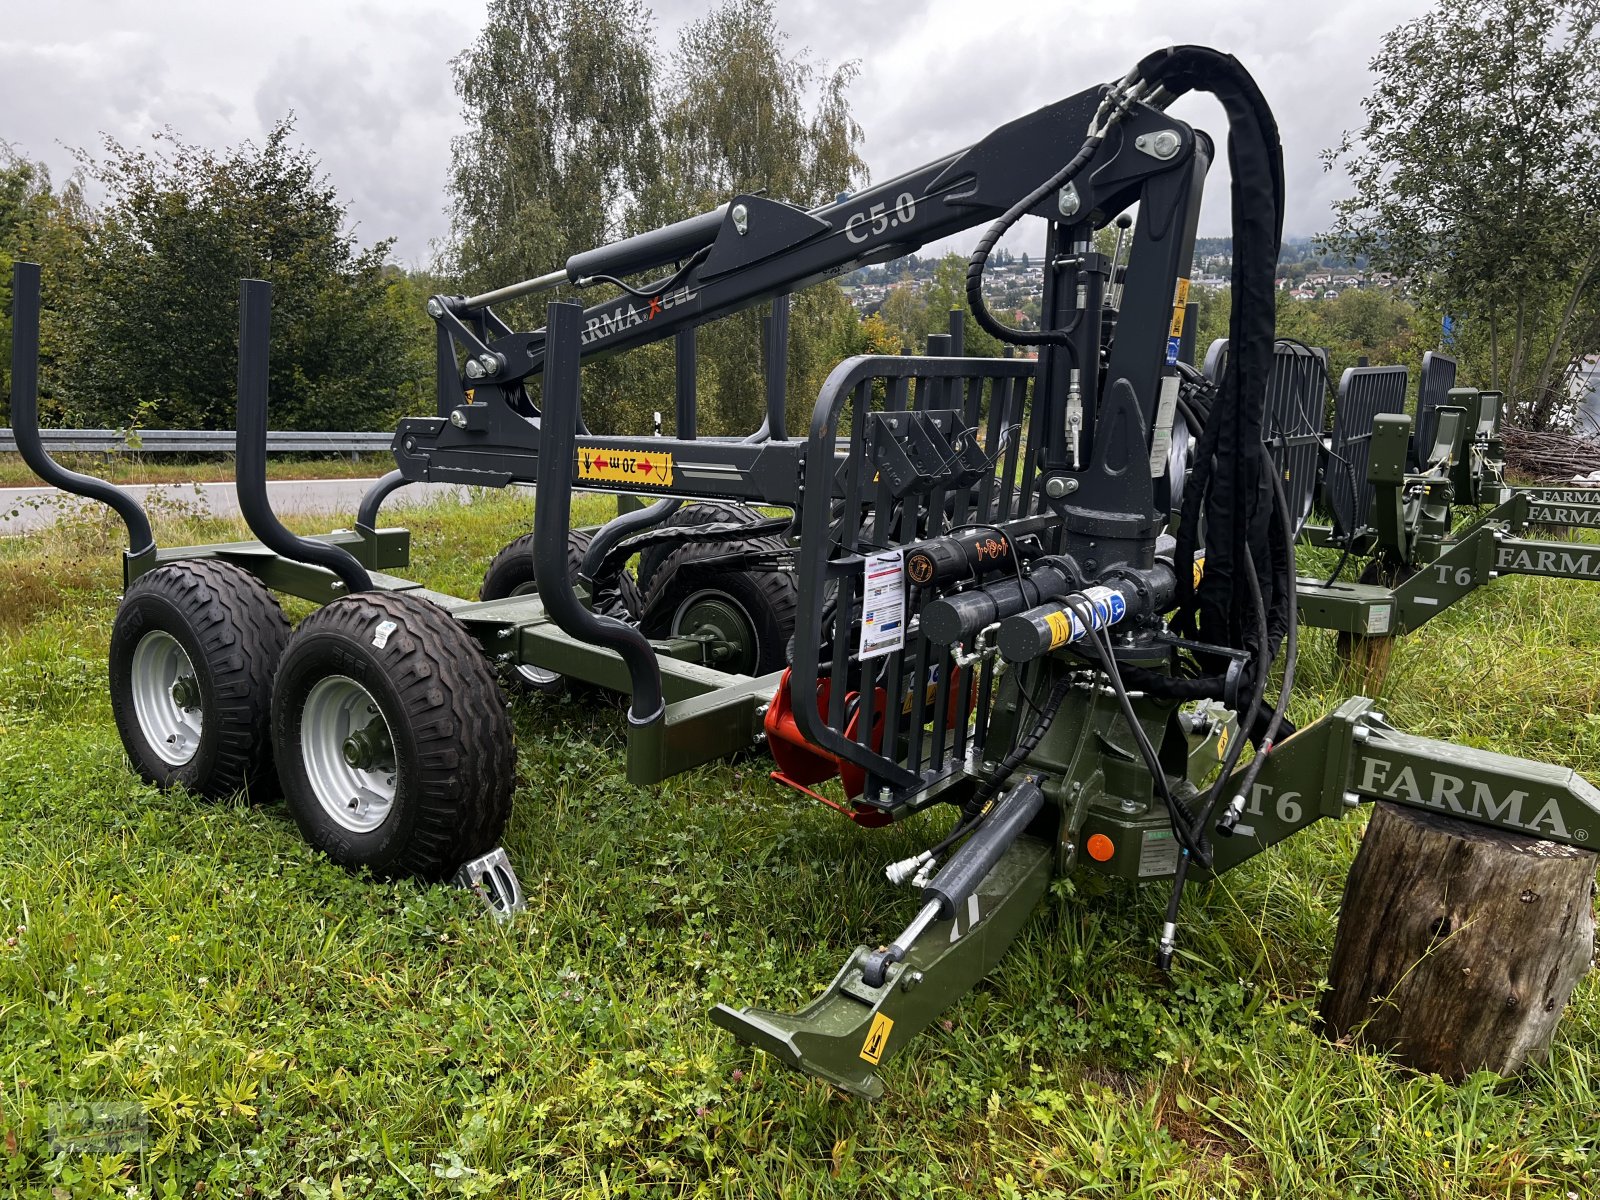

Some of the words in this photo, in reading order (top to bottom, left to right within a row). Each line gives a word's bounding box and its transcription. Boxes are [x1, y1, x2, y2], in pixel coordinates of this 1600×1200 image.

[609, 456, 620, 469] m
[622, 457, 636, 474] 20
[1434, 564, 1471, 586] T6
[1246, 782, 1302, 823] T6
